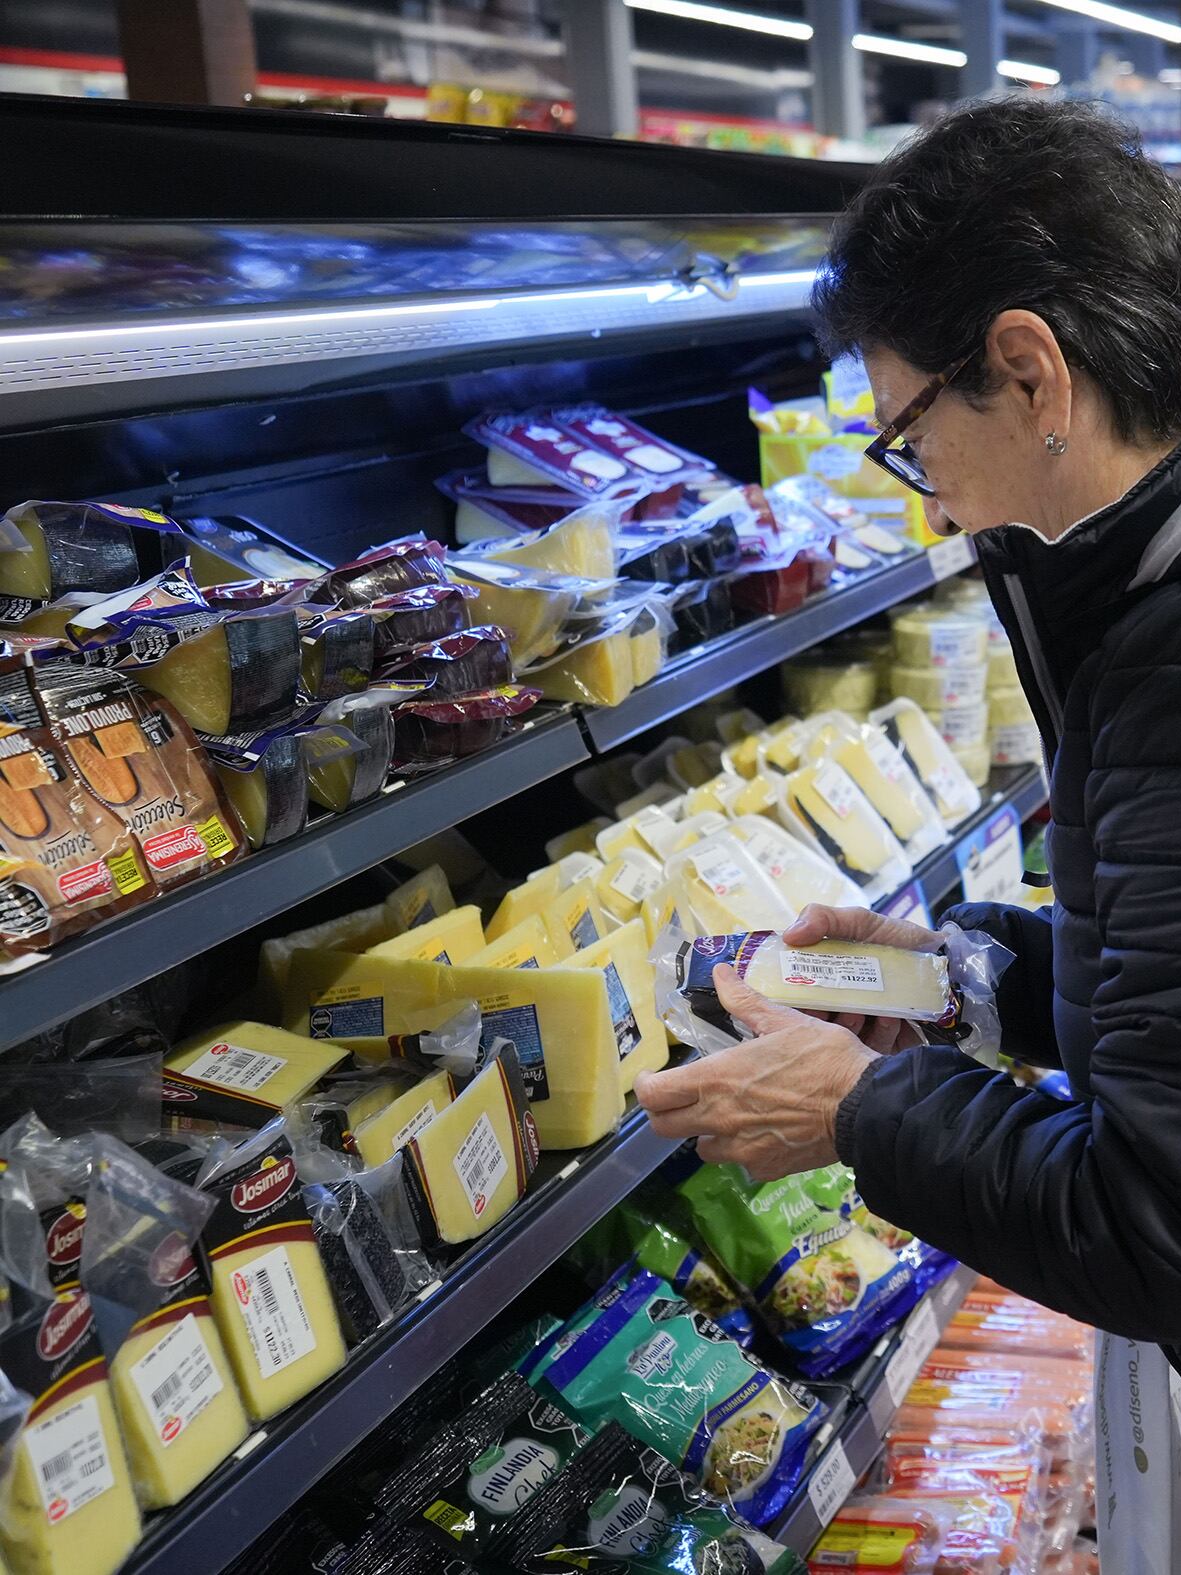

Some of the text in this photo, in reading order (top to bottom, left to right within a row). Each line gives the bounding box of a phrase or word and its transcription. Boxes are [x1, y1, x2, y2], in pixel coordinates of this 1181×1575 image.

[63, 700, 134, 737] PROVOLONE
[238, 1161, 291, 1207] Josimar
[481, 1445, 544, 1503] FINLANDIA
[600, 1496, 652, 1549] FINLANDIA
